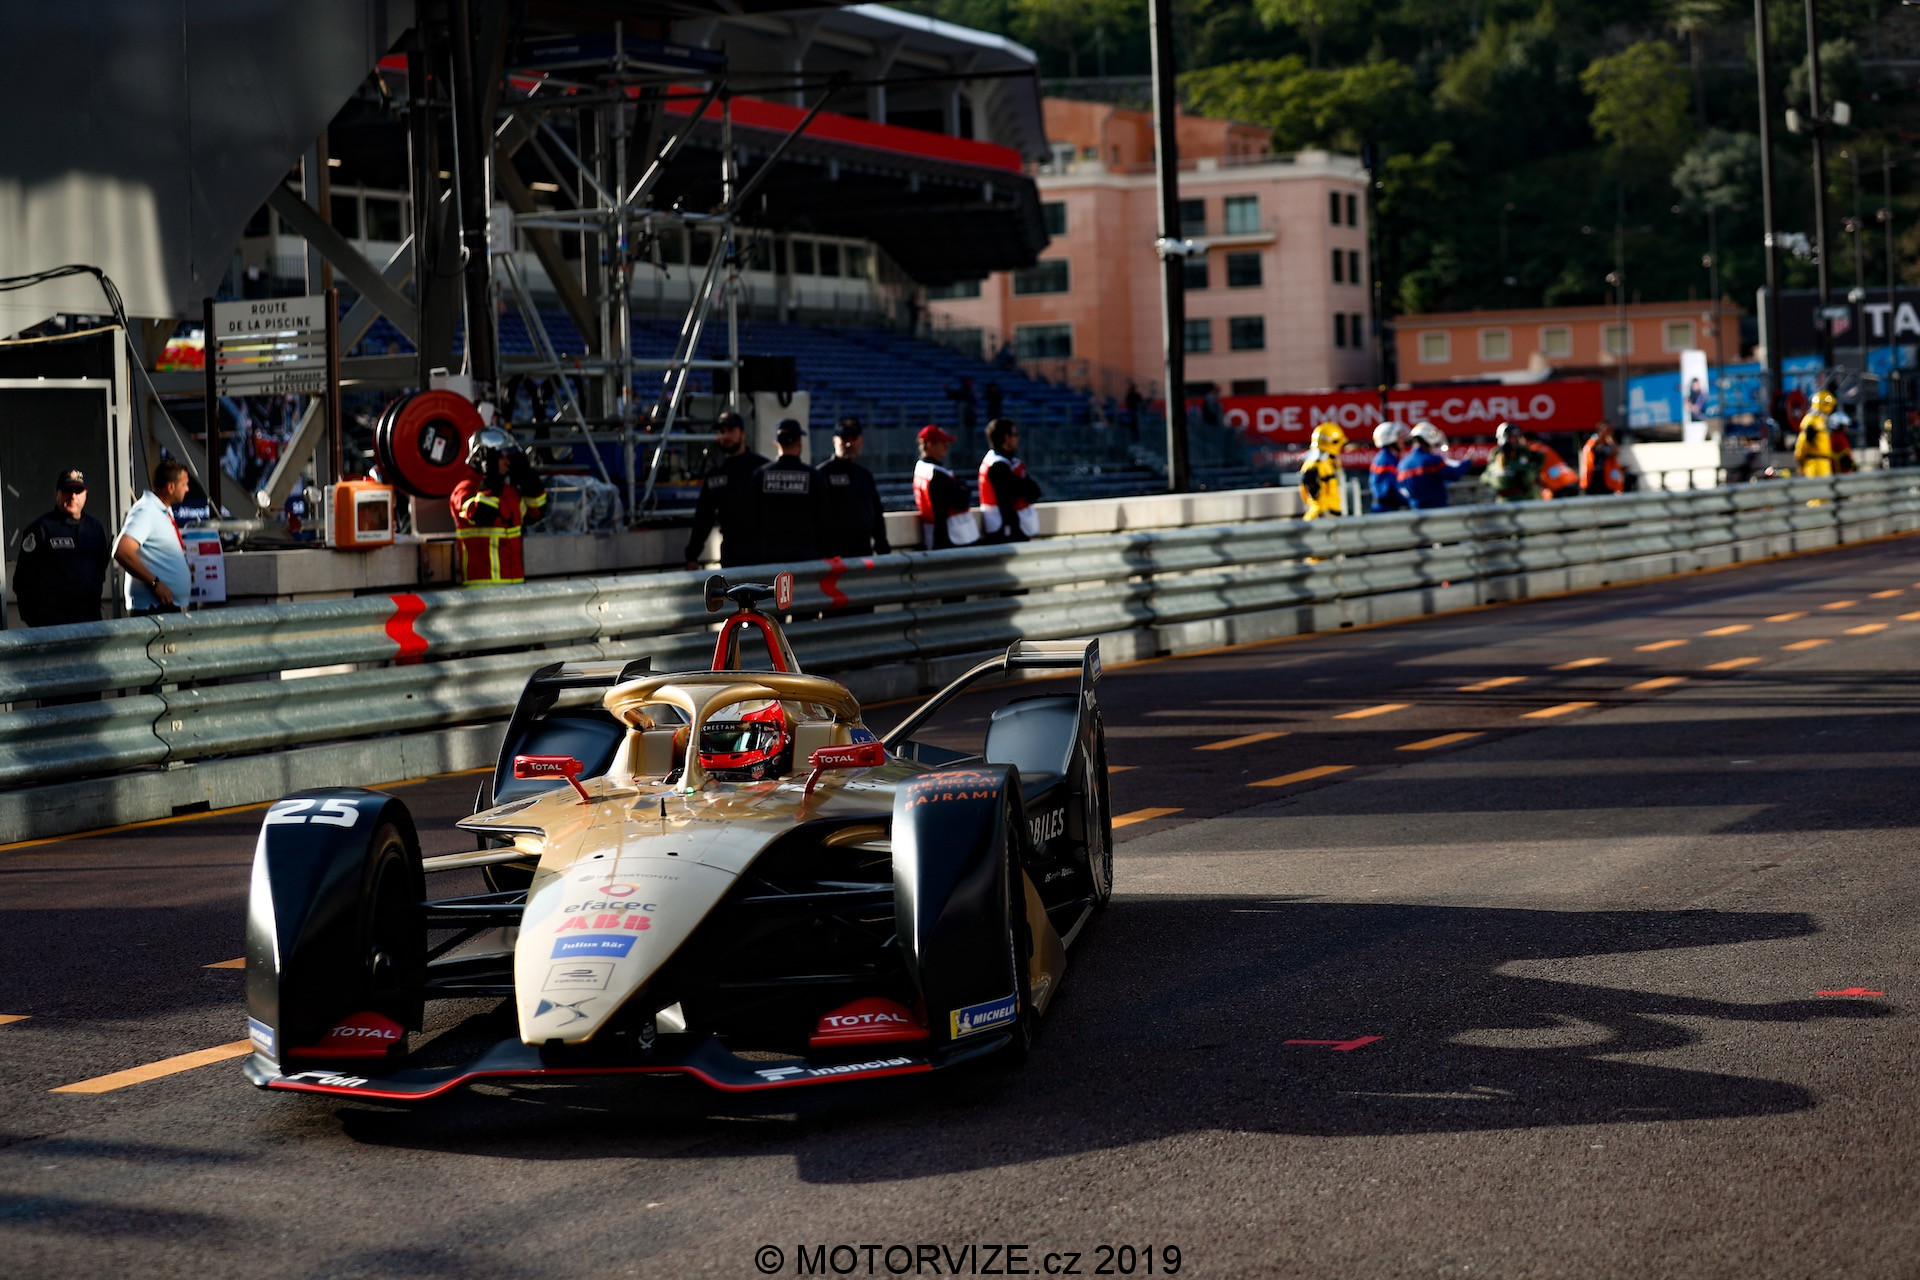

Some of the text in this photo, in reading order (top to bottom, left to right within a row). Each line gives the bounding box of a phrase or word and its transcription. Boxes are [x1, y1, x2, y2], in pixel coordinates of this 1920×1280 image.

[252, 303, 288, 314] ROUTE
[229, 316, 311, 332] DE LA PISCINE
[1256, 407, 1304, 433] DE
[1310, 394, 1556, 426] MONTE-CARLO
[779, 575, 791, 603] JEV
[819, 753, 854, 764] TOTAL
[530, 761, 562, 771] TOTAL
[904, 790, 998, 812] BAJRAMI
[267, 799, 360, 827] 25
[564, 900, 657, 913] efacec
[554, 914, 652, 933] ABB
[562, 941, 625, 950] Julius Bär
[824, 1013, 908, 1026] TOTAL
[332, 1026, 395, 1038] TOTAL
